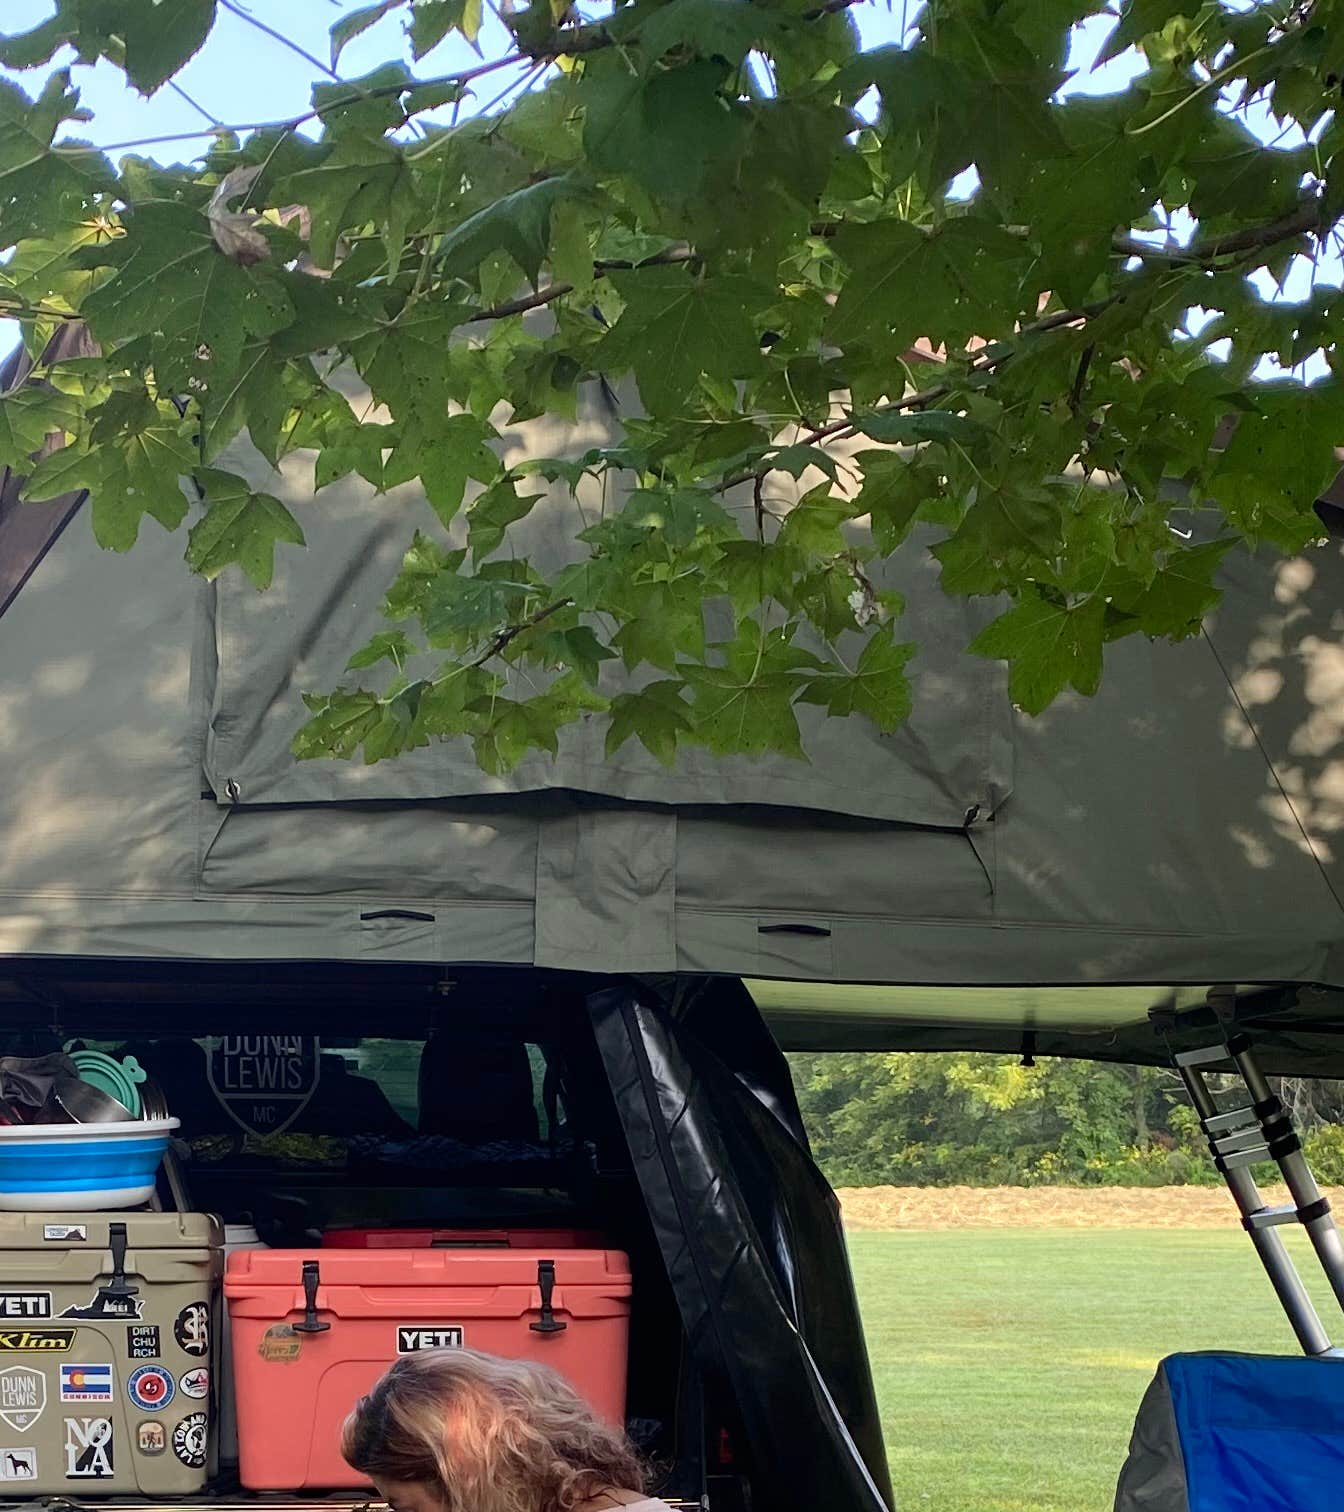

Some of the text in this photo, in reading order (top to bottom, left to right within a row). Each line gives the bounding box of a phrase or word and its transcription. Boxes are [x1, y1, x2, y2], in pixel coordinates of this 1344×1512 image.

[224, 1057, 303, 1089] LEWIS
[253, 1106, 276, 1122] MC
[132, 1326, 155, 1336] DIRT
[132, 1337, 156, 1347] CHU
[400, 1331, 463, 1349] YETI
[133, 1348, 156, 1357] RCH
[1, 1376, 36, 1393] DUNN
[2, 1392, 37, 1406] LEWIS
